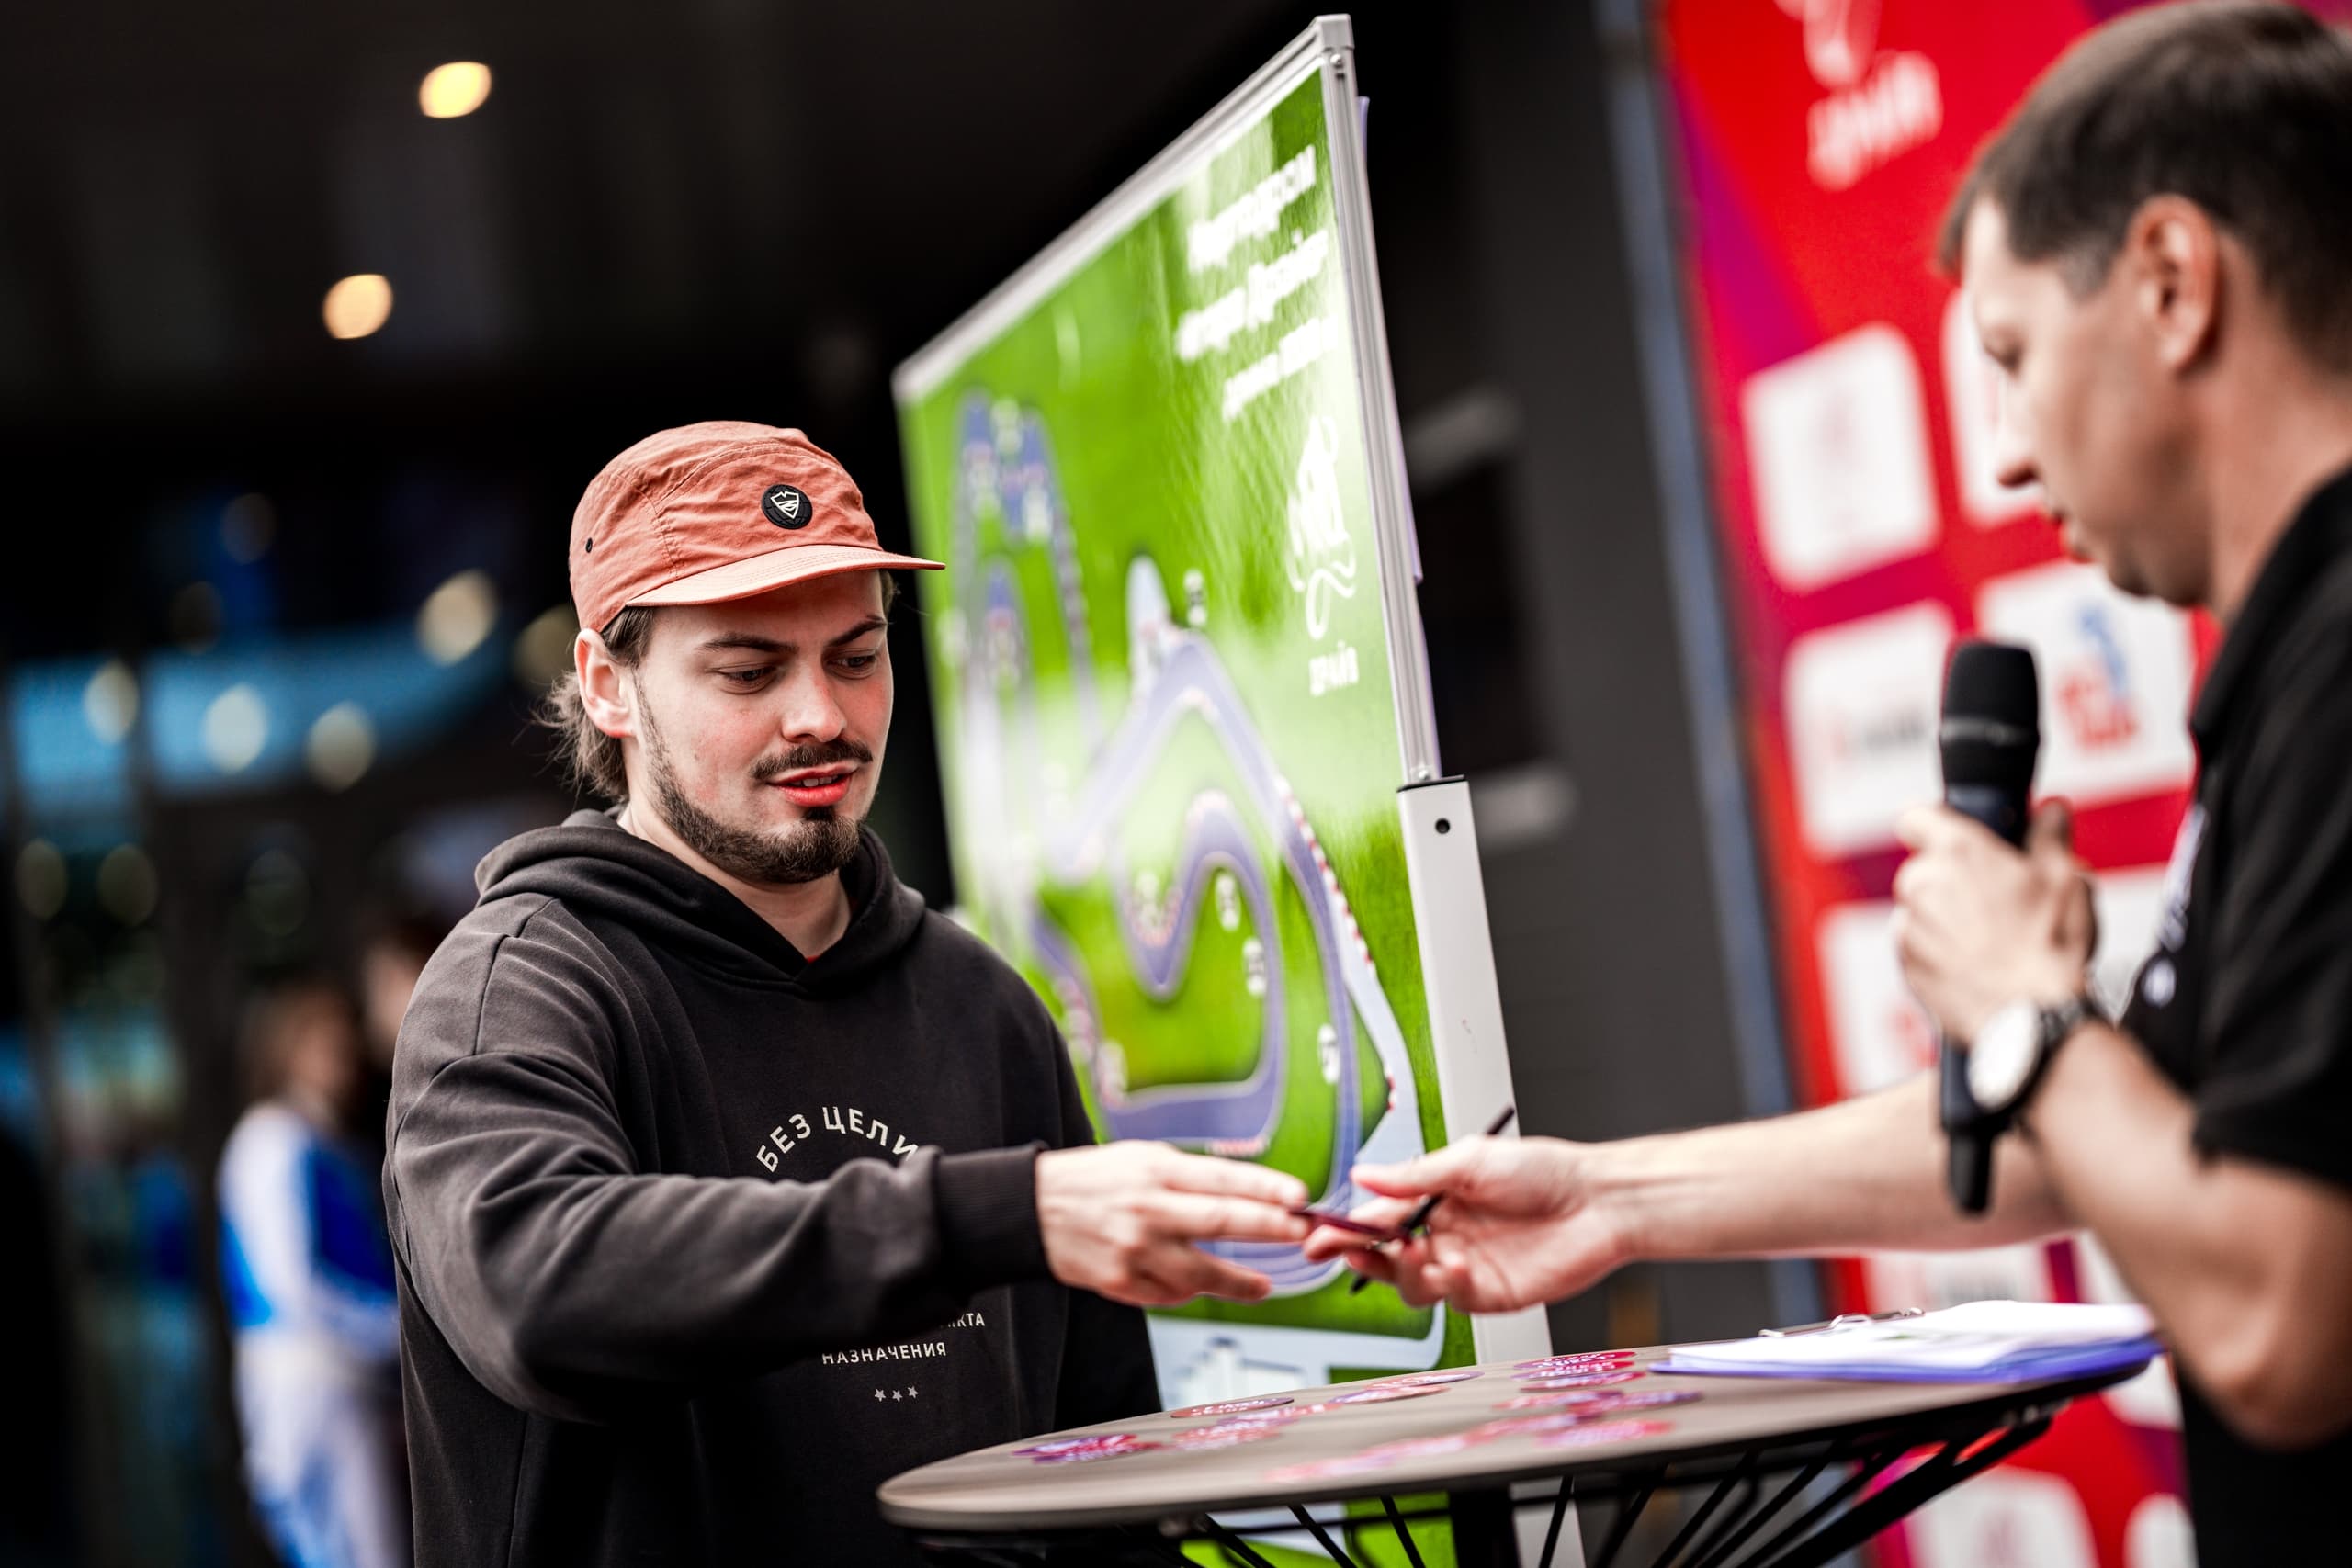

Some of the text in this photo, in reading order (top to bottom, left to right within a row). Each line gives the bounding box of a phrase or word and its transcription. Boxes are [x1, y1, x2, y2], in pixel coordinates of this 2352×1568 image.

[756, 1106, 919, 1173] БЕЗ ЦЕЛИ
[821, 1341, 947, 1365] НАЗНАЧЕНИЯ
